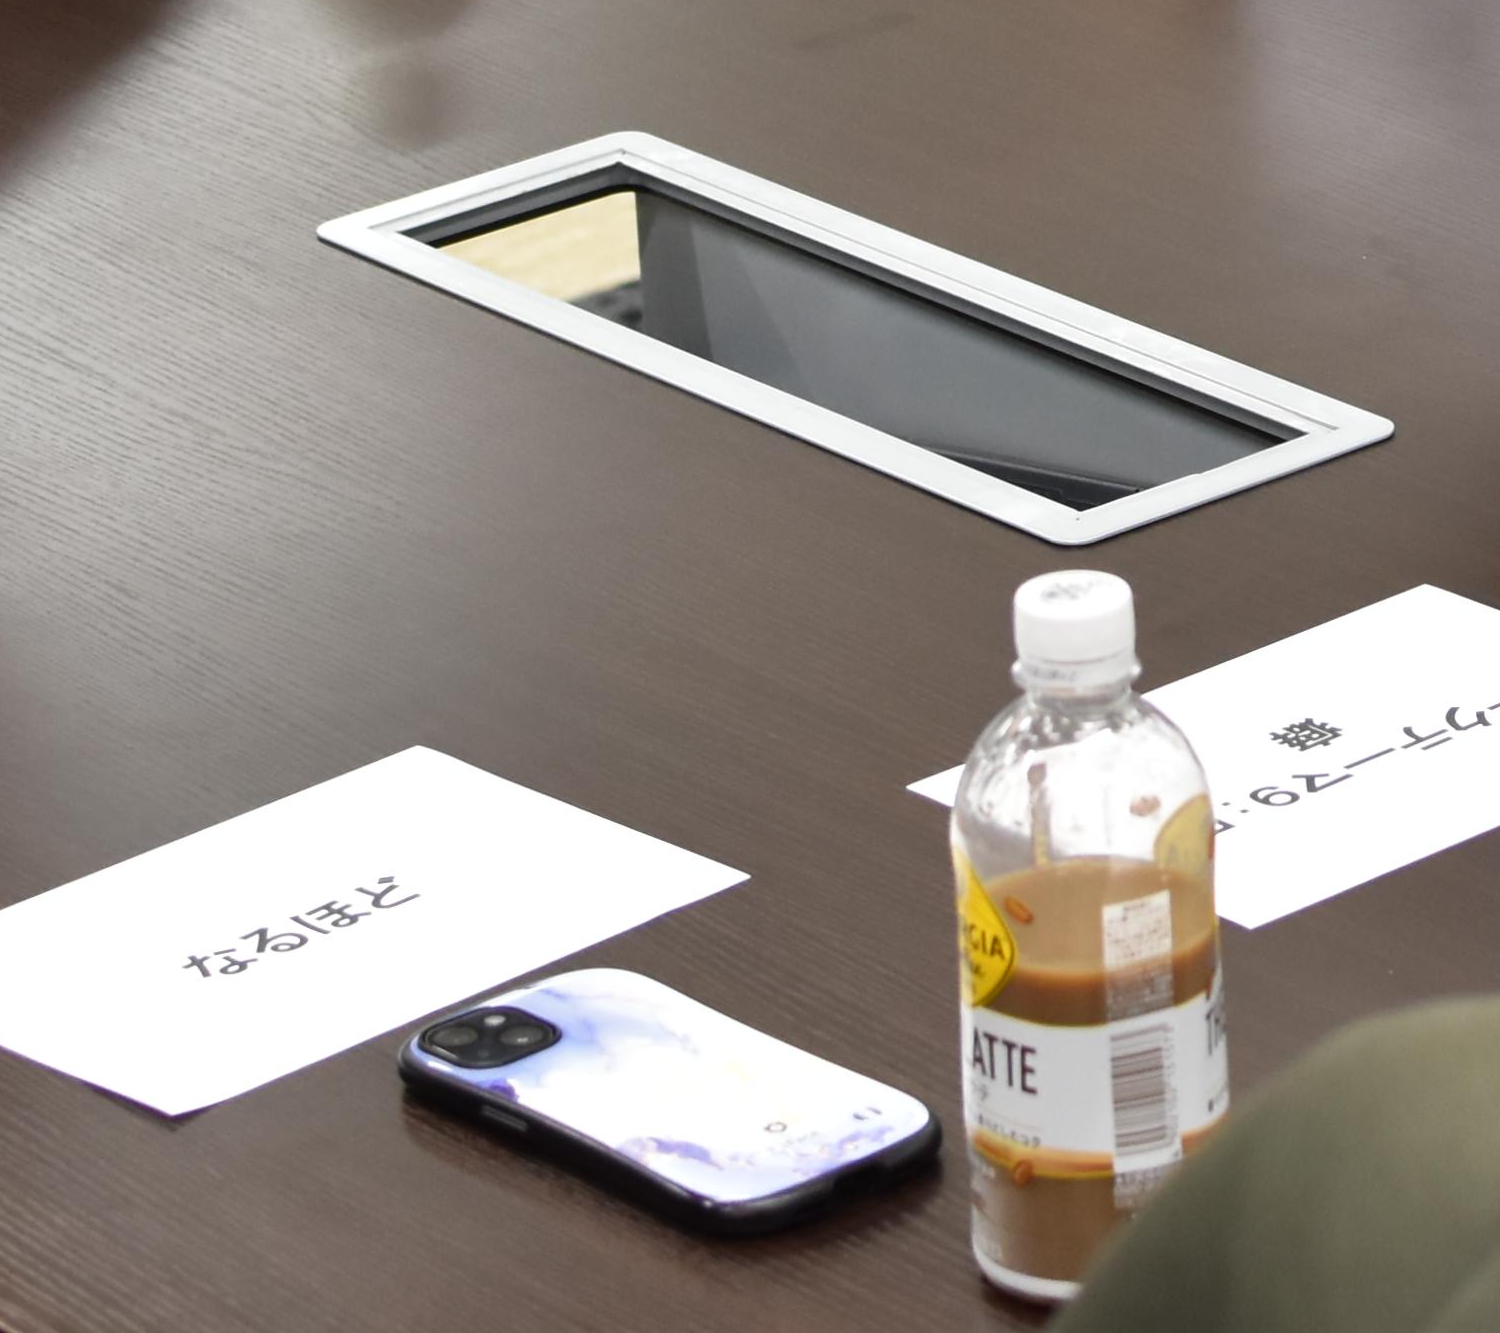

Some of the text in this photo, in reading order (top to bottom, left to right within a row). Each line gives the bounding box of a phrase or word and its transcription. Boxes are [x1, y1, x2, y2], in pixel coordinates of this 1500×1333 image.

[1268, 717, 1343, 752] 癖
[181, 875, 421, 978] なるほど
[970, 1026, 1038, 1097] ATTE
